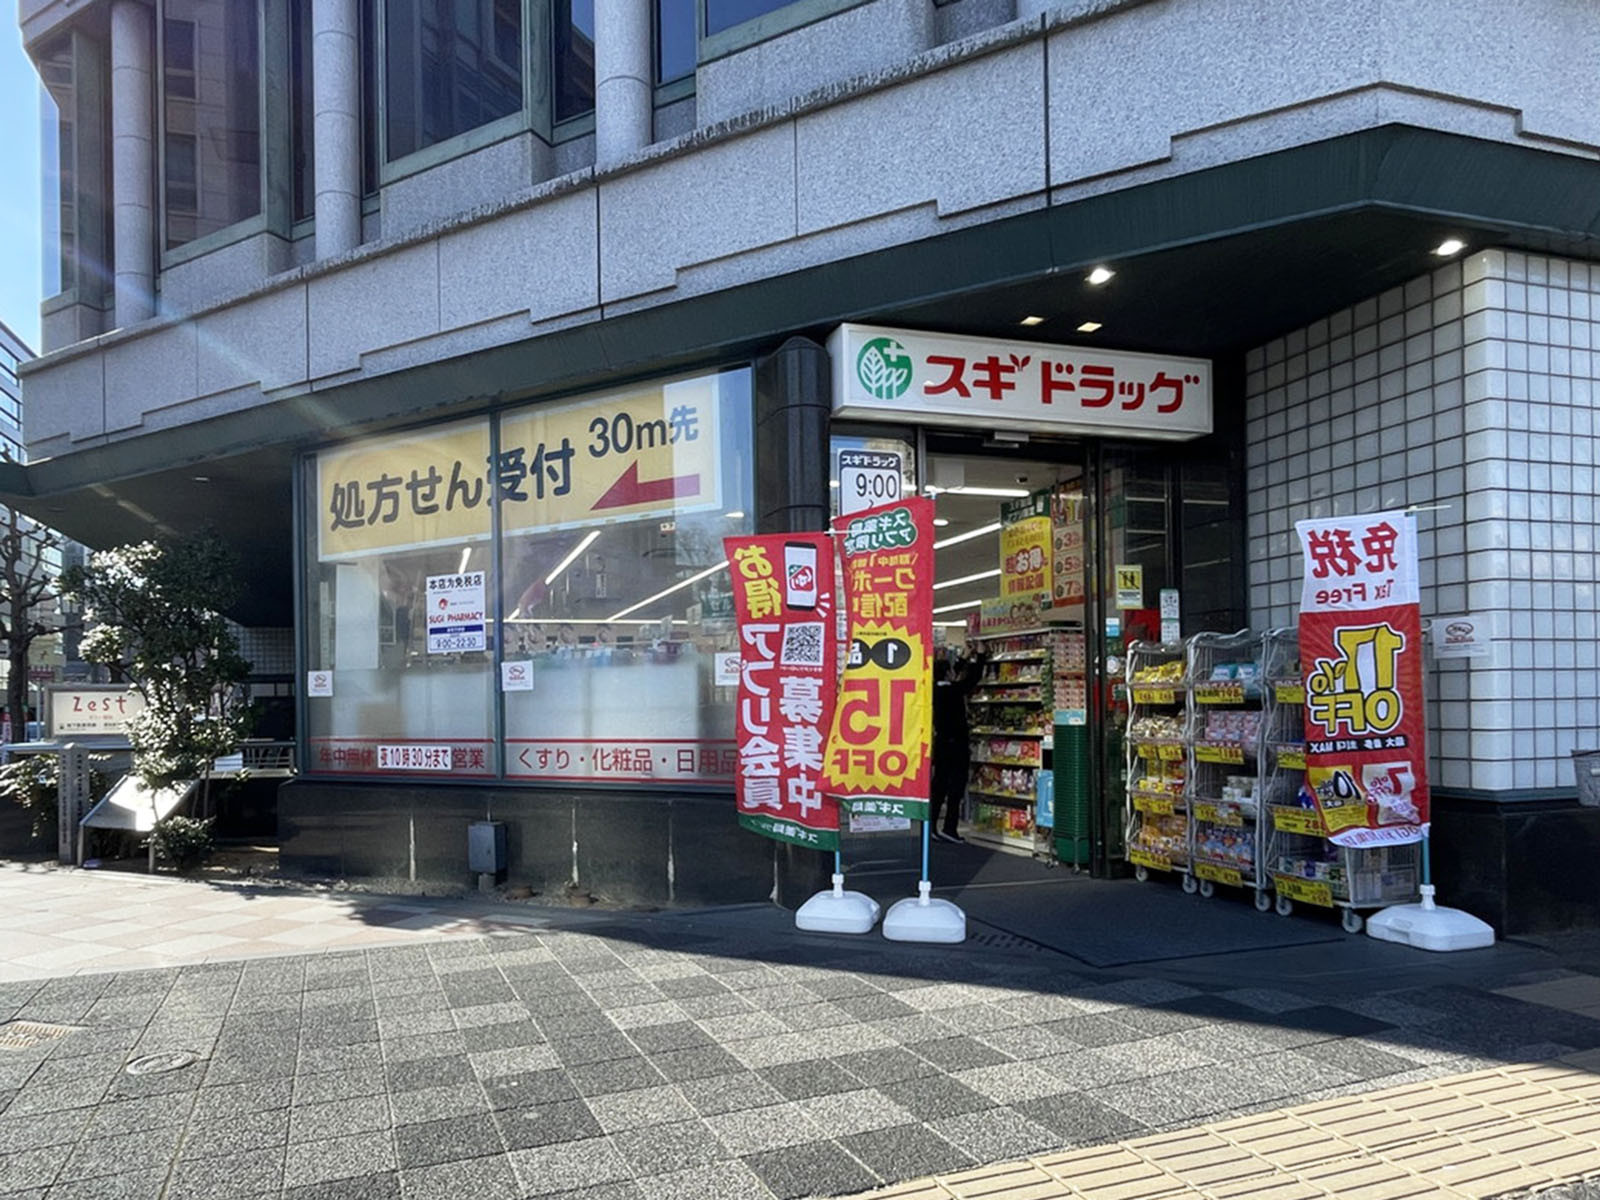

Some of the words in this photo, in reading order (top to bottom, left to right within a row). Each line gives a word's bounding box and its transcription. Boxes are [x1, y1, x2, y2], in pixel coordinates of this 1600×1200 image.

[923, 353, 1201, 413] スギドラッグ
[588, 405, 700, 458] 30m先
[330, 438, 575, 531] 処方せん受付
[856, 473, 897, 498] 9:00
[429, 614, 444, 624] SUGI
[447, 611, 483, 622] PHARMACY
[73, 695, 127, 714] Zest
[453, 748, 485, 769] 営業
